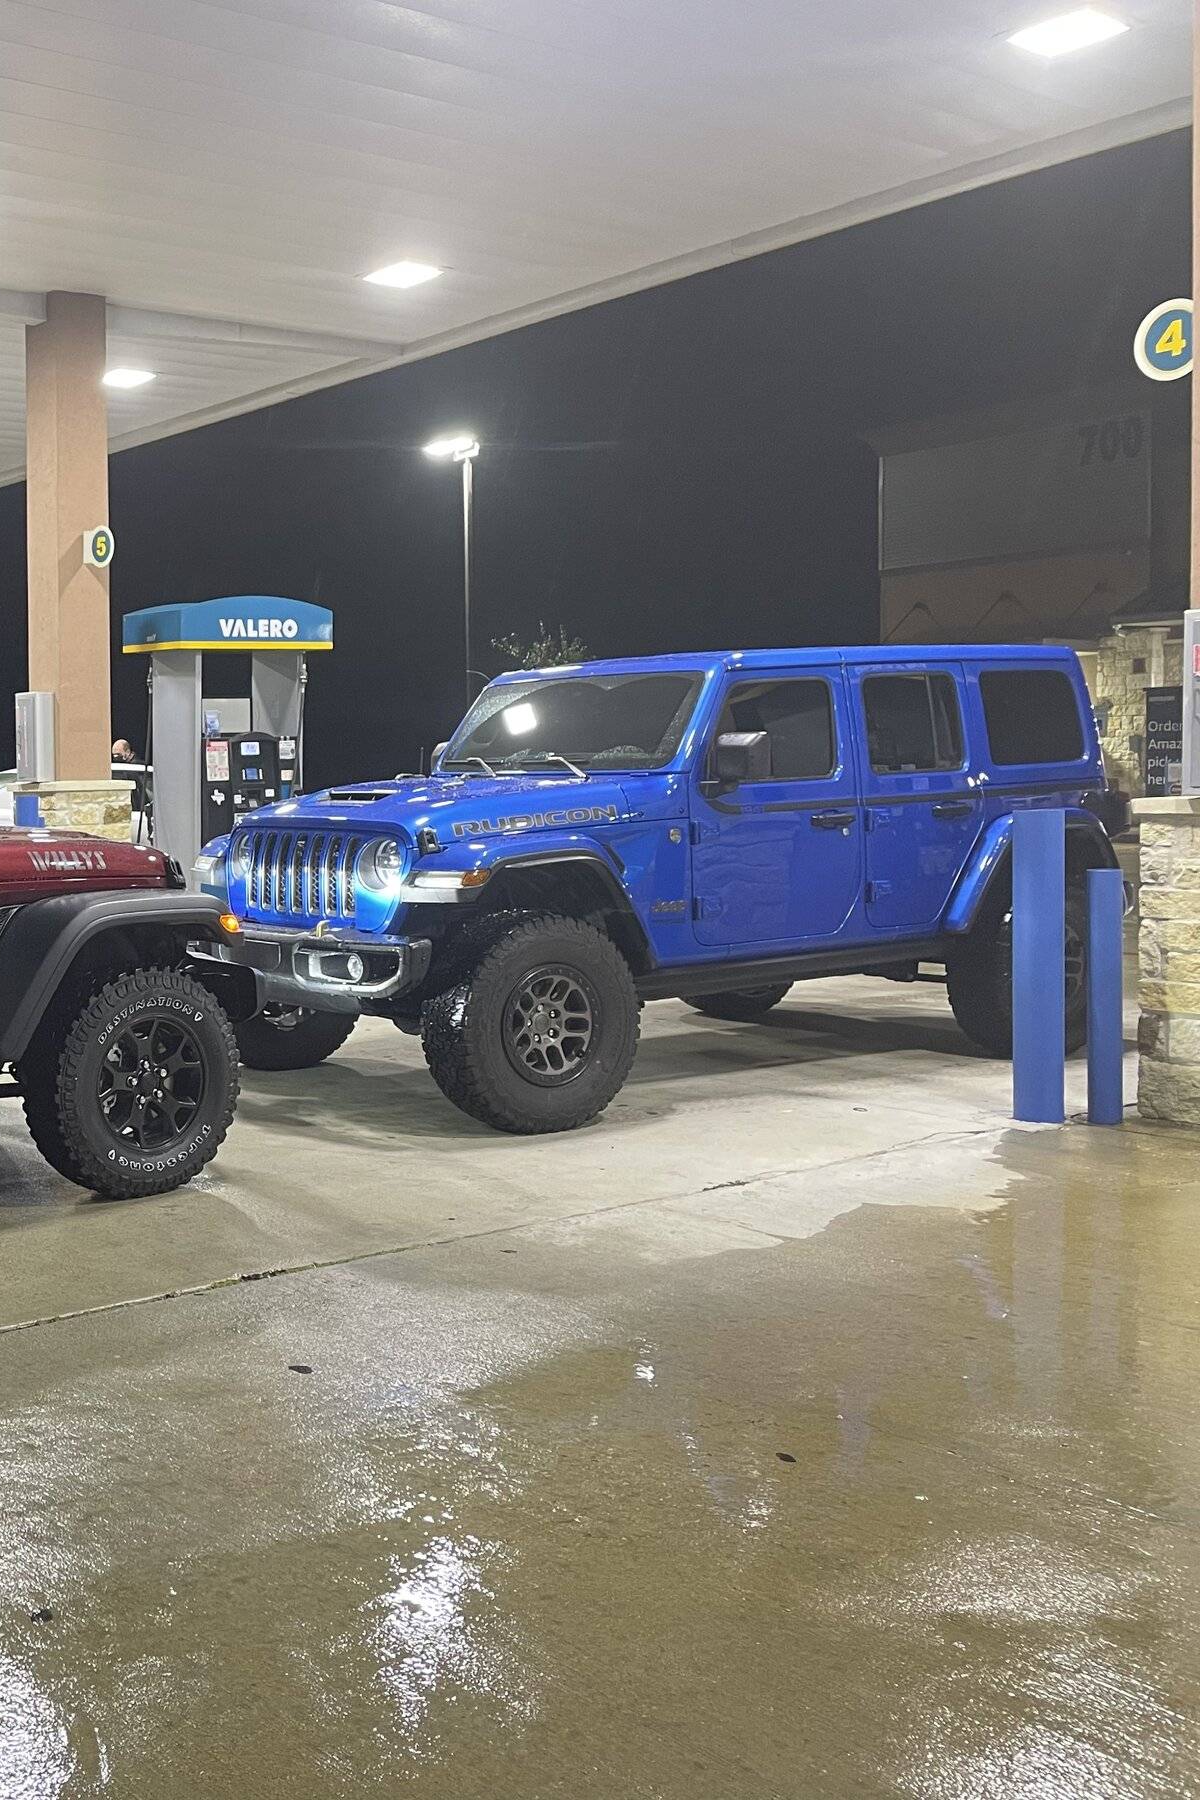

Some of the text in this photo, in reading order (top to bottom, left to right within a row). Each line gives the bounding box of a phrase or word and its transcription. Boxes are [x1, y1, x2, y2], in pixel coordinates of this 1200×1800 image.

[1155, 319, 1187, 357] 4
[96, 536, 106, 556] 5
[218, 618, 299, 639] VALERO
[452, 804, 618, 837] RUBICON
[27, 850, 107, 872] WILLYS
[97, 996, 194, 1045] DESTINATION
